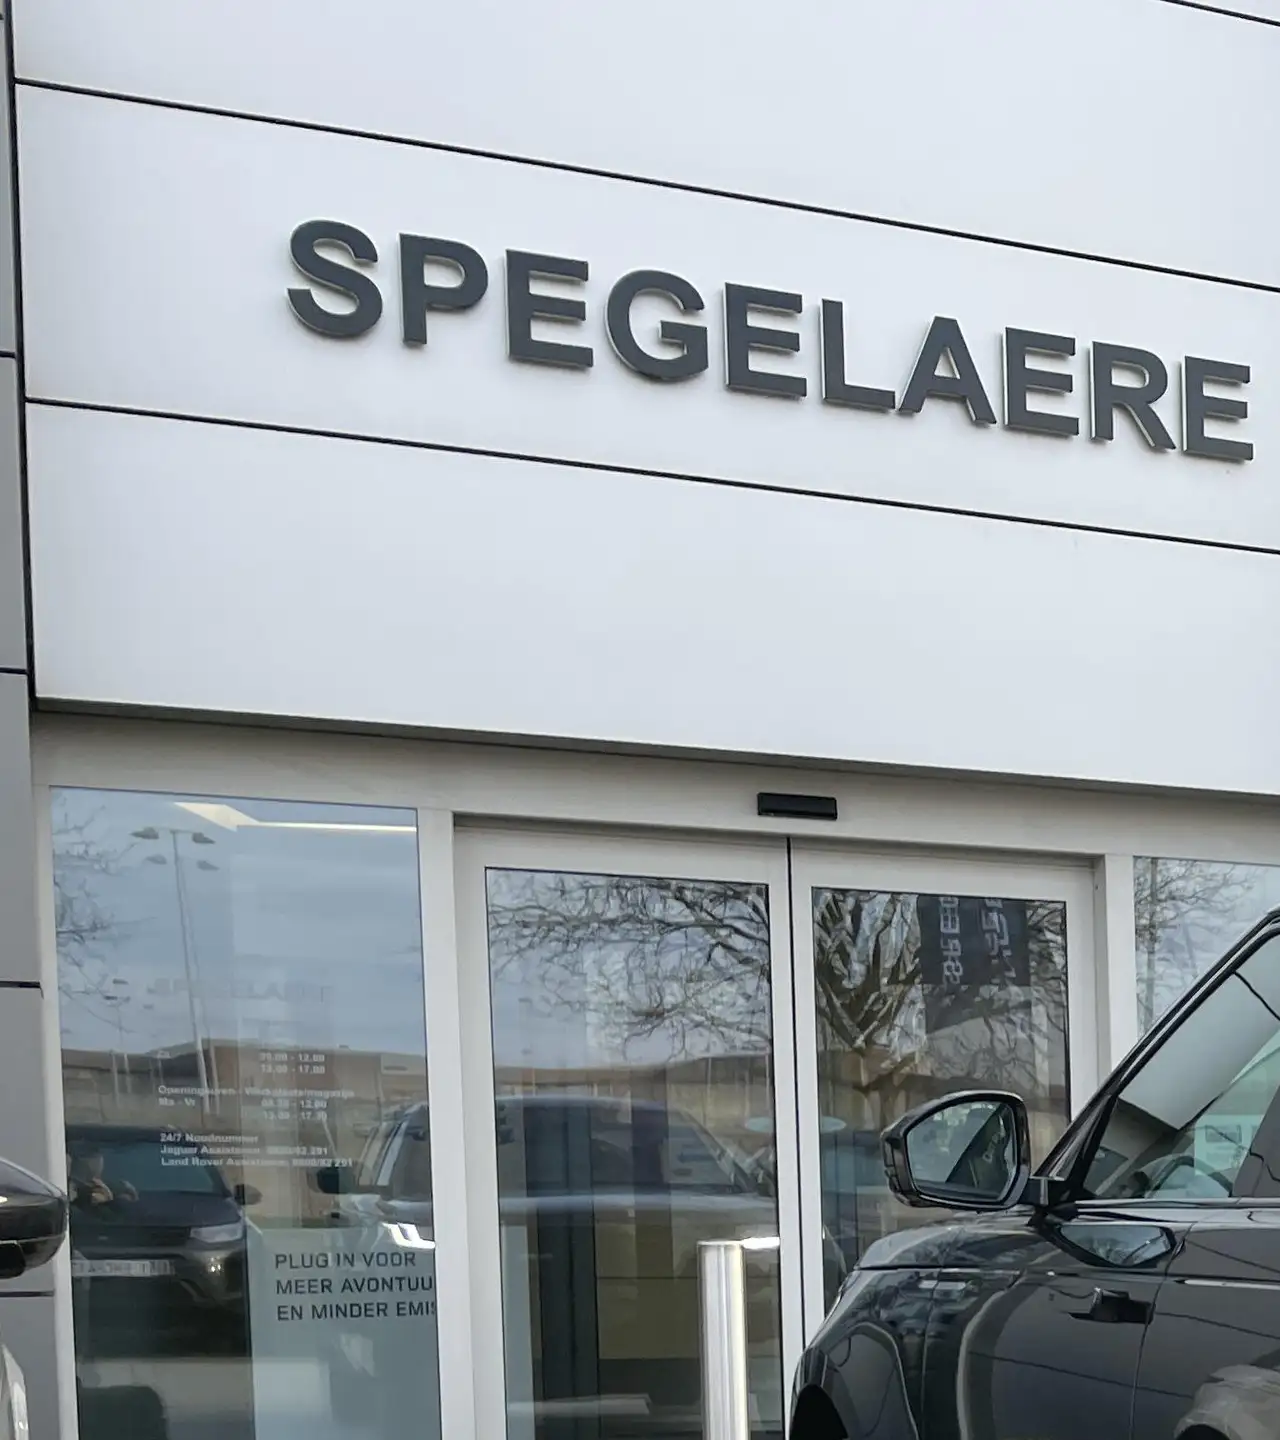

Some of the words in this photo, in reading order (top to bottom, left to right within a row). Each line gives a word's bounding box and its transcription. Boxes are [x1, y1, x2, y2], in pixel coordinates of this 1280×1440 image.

[287, 219, 1254, 461] SPEGELAERE
[160, 1132, 182, 1143] 24/7
[161, 1157, 188, 1167] Land
[192, 1157, 223, 1167] Rover
[275, 1253, 329, 1269] PLUG
[336, 1252, 355, 1267] IN
[361, 1251, 416, 1267] VOOR
[276, 1278, 332, 1295] MEER
[277, 1305, 303, 1321] EN
[311, 1302, 388, 1319] MINDER
